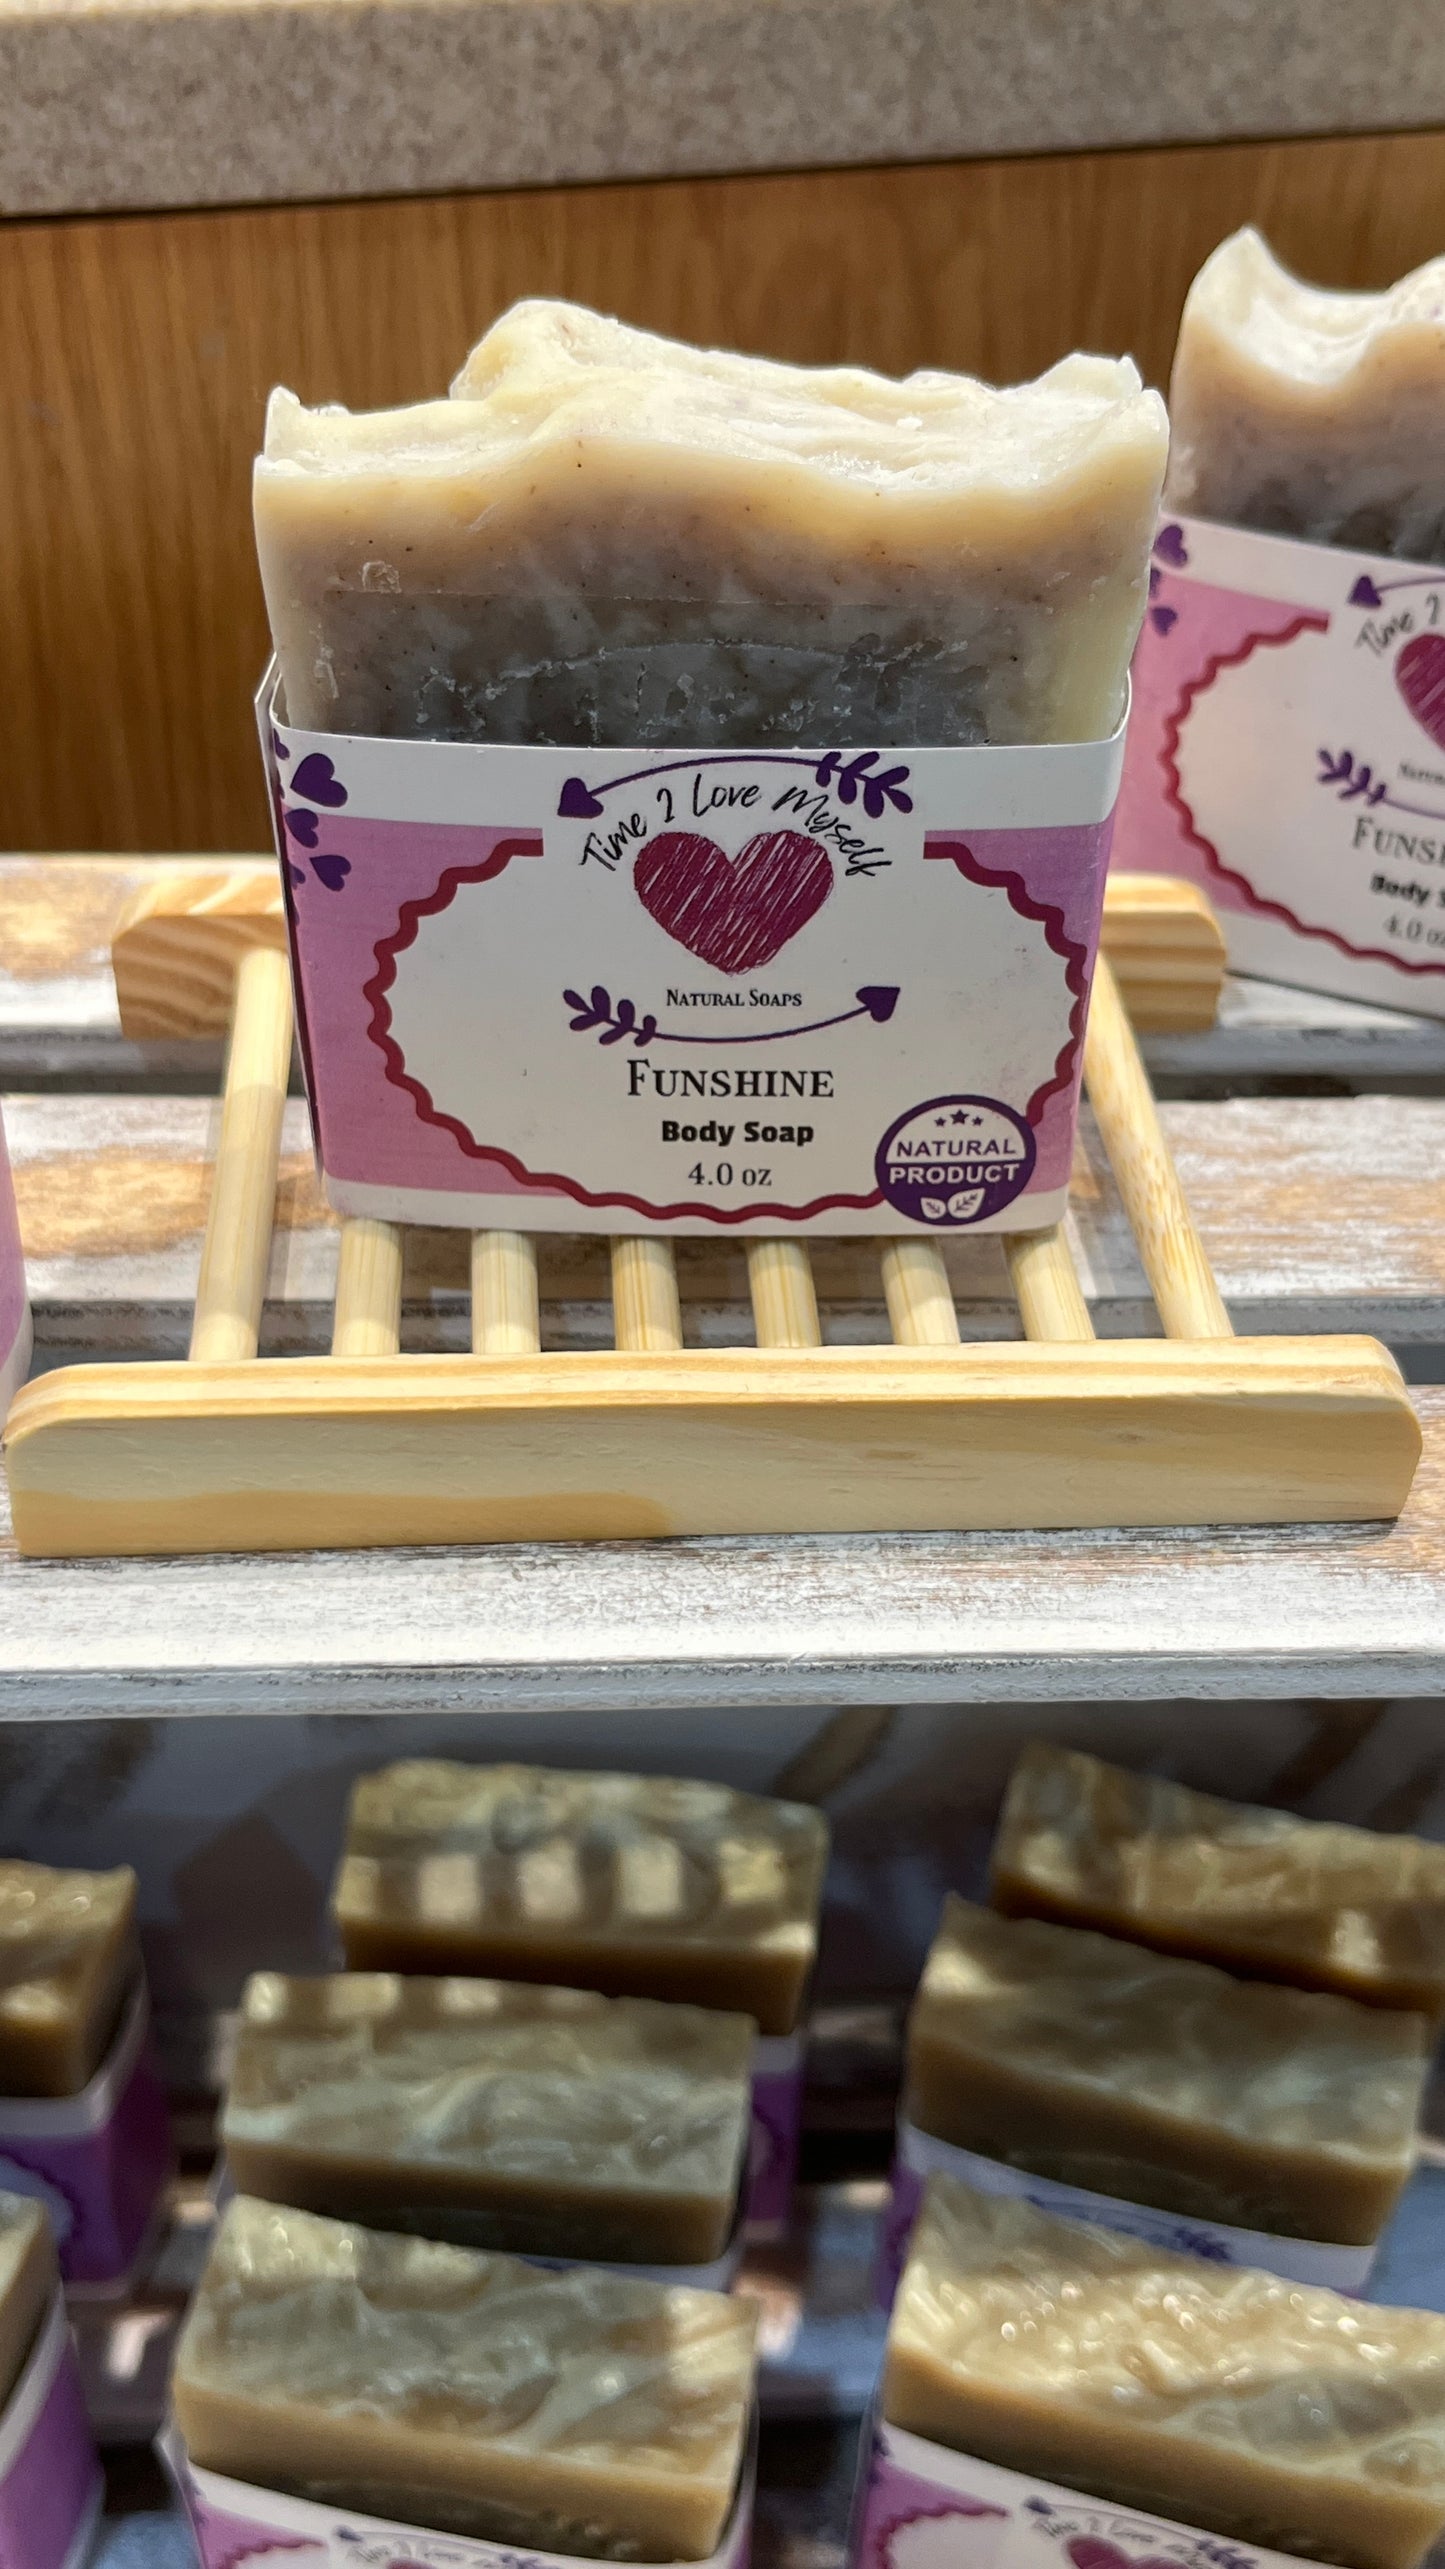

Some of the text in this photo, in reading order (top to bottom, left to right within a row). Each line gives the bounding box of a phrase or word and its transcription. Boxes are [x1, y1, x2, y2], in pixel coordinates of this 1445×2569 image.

[579, 773, 893, 878] Time 2 Love Myself
[661, 1121, 815, 1146] Body Soap
[896, 1139, 1017, 1158] NATURAL
[688, 1163, 773, 1187] 4.0 oz
[889, 1163, 1020, 1185] PRODUCT
